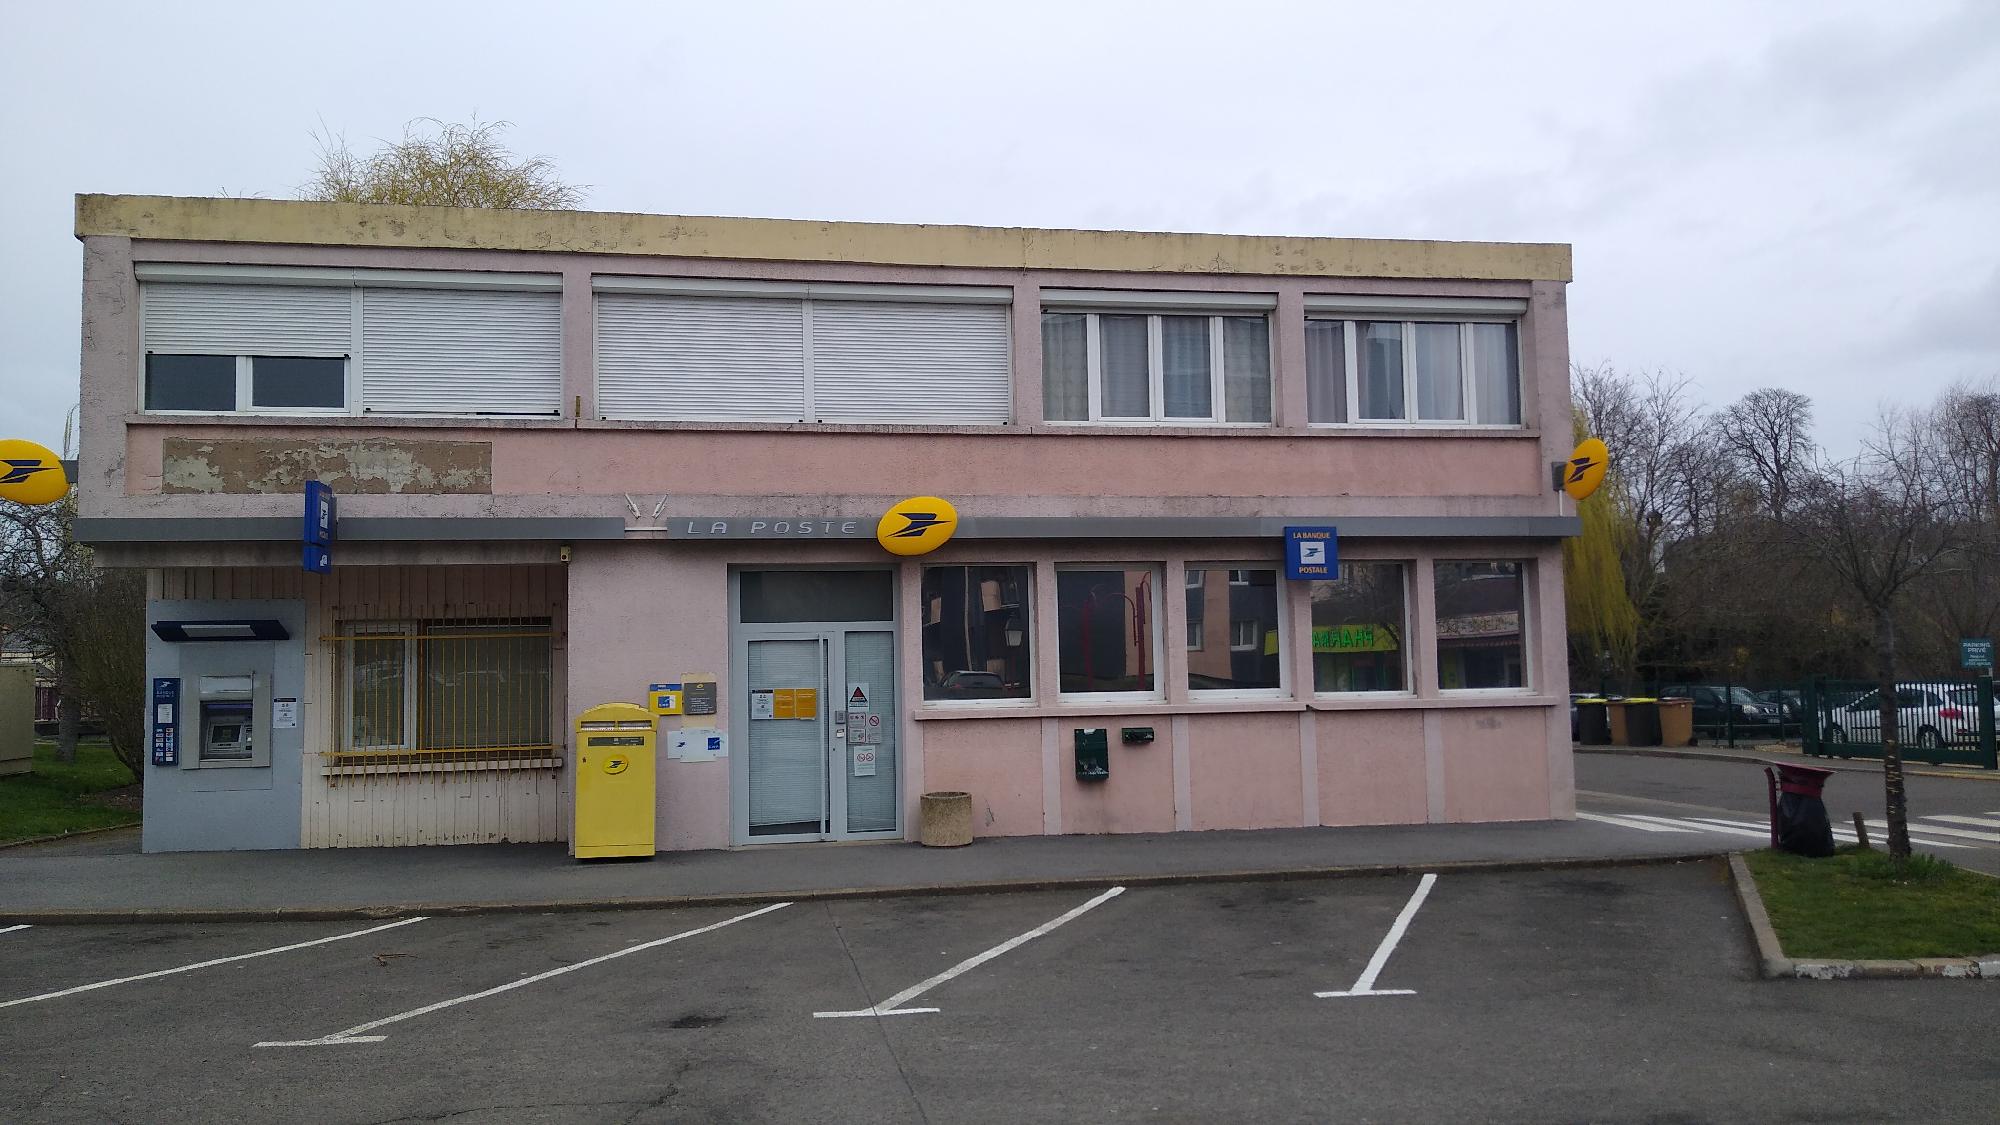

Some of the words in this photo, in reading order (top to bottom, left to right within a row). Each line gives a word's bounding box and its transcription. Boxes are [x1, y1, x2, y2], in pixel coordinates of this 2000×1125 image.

[687, 521, 728, 534] LA
[750, 521, 857, 534] POSTE
[1298, 566, 1328, 574] POSTALE
